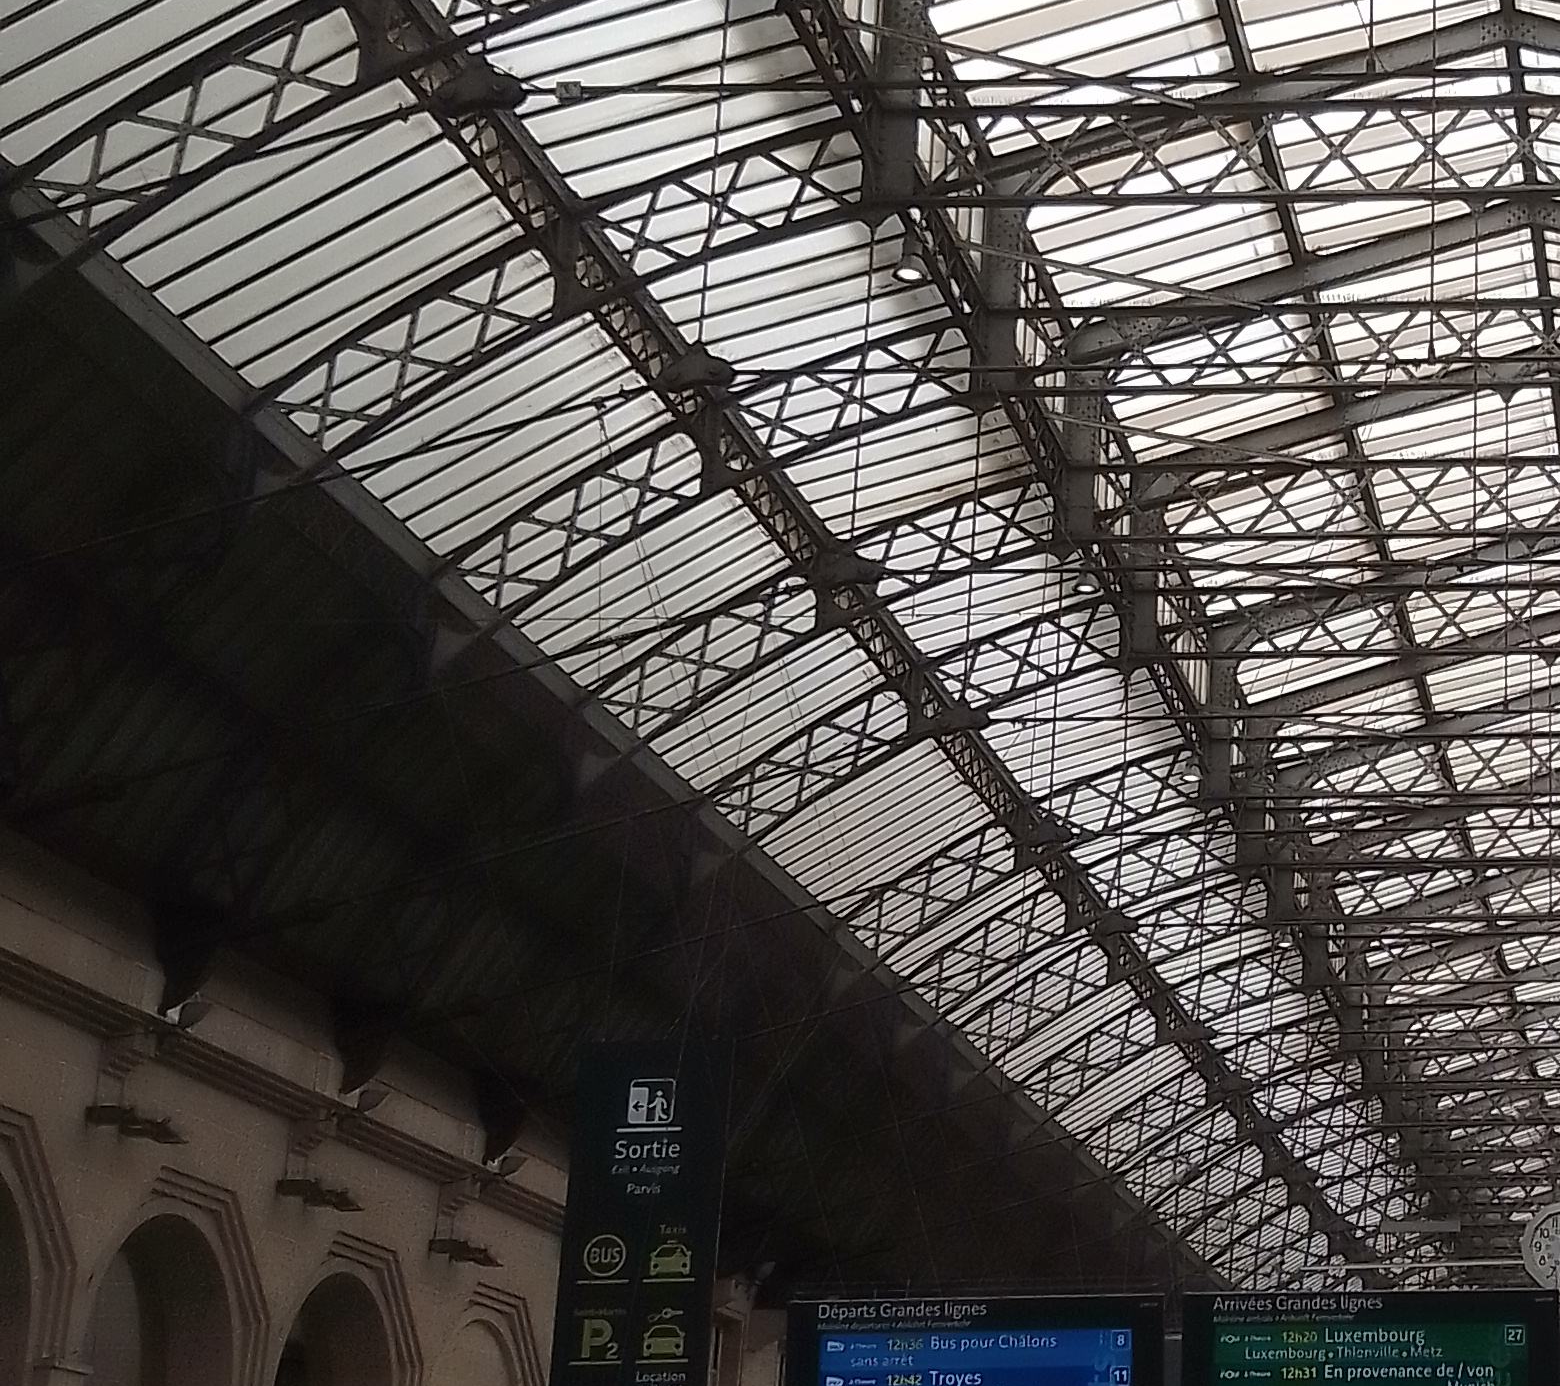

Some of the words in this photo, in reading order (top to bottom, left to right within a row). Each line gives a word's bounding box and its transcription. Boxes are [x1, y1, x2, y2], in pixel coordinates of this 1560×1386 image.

[615, 1137, 681, 1160] Sortie
[626, 1183, 661, 1194] Parvis
[588, 1247, 622, 1264] BUS
[818, 1303, 877, 1321] Départs
[879, 1302, 942, 1318] Grandes
[944, 1301, 989, 1319] lignes
[1213, 1296, 1273, 1313] Arrivées
[1275, 1295, 1338, 1312] Grandes
[1340, 1293, 1384, 1313] lignes
[930, 1335, 957, 1350] Bus
[961, 1338, 995, 1353] pour
[998, 1333, 1058, 1349] Châlons
[1114, 1333, 1127, 1347] 8
[1280, 1331, 1318, 1344] 12h20
[1325, 1327, 1426, 1346] Luxembourg
[1508, 1328, 1523, 1342] 27
[850, 1356, 879, 1368] sans
[881, 1353, 914, 1368] arrêt
[1244, 1346, 1326, 1362] Luxembourg
[1336, 1345, 1400, 1359] Thionville
[1410, 1345, 1443, 1359] Metz
[635, 1370, 687, 1383] Location
[1113, 1369, 1128, 1384] 11
[1280, 1366, 1318, 1380] 12h31
[1324, 1364, 1344, 1379] En
[1347, 1366, 1432, 1382] provenance
[1435, 1363, 1455, 1379] de
[1467, 1364, 1494, 1378] von
